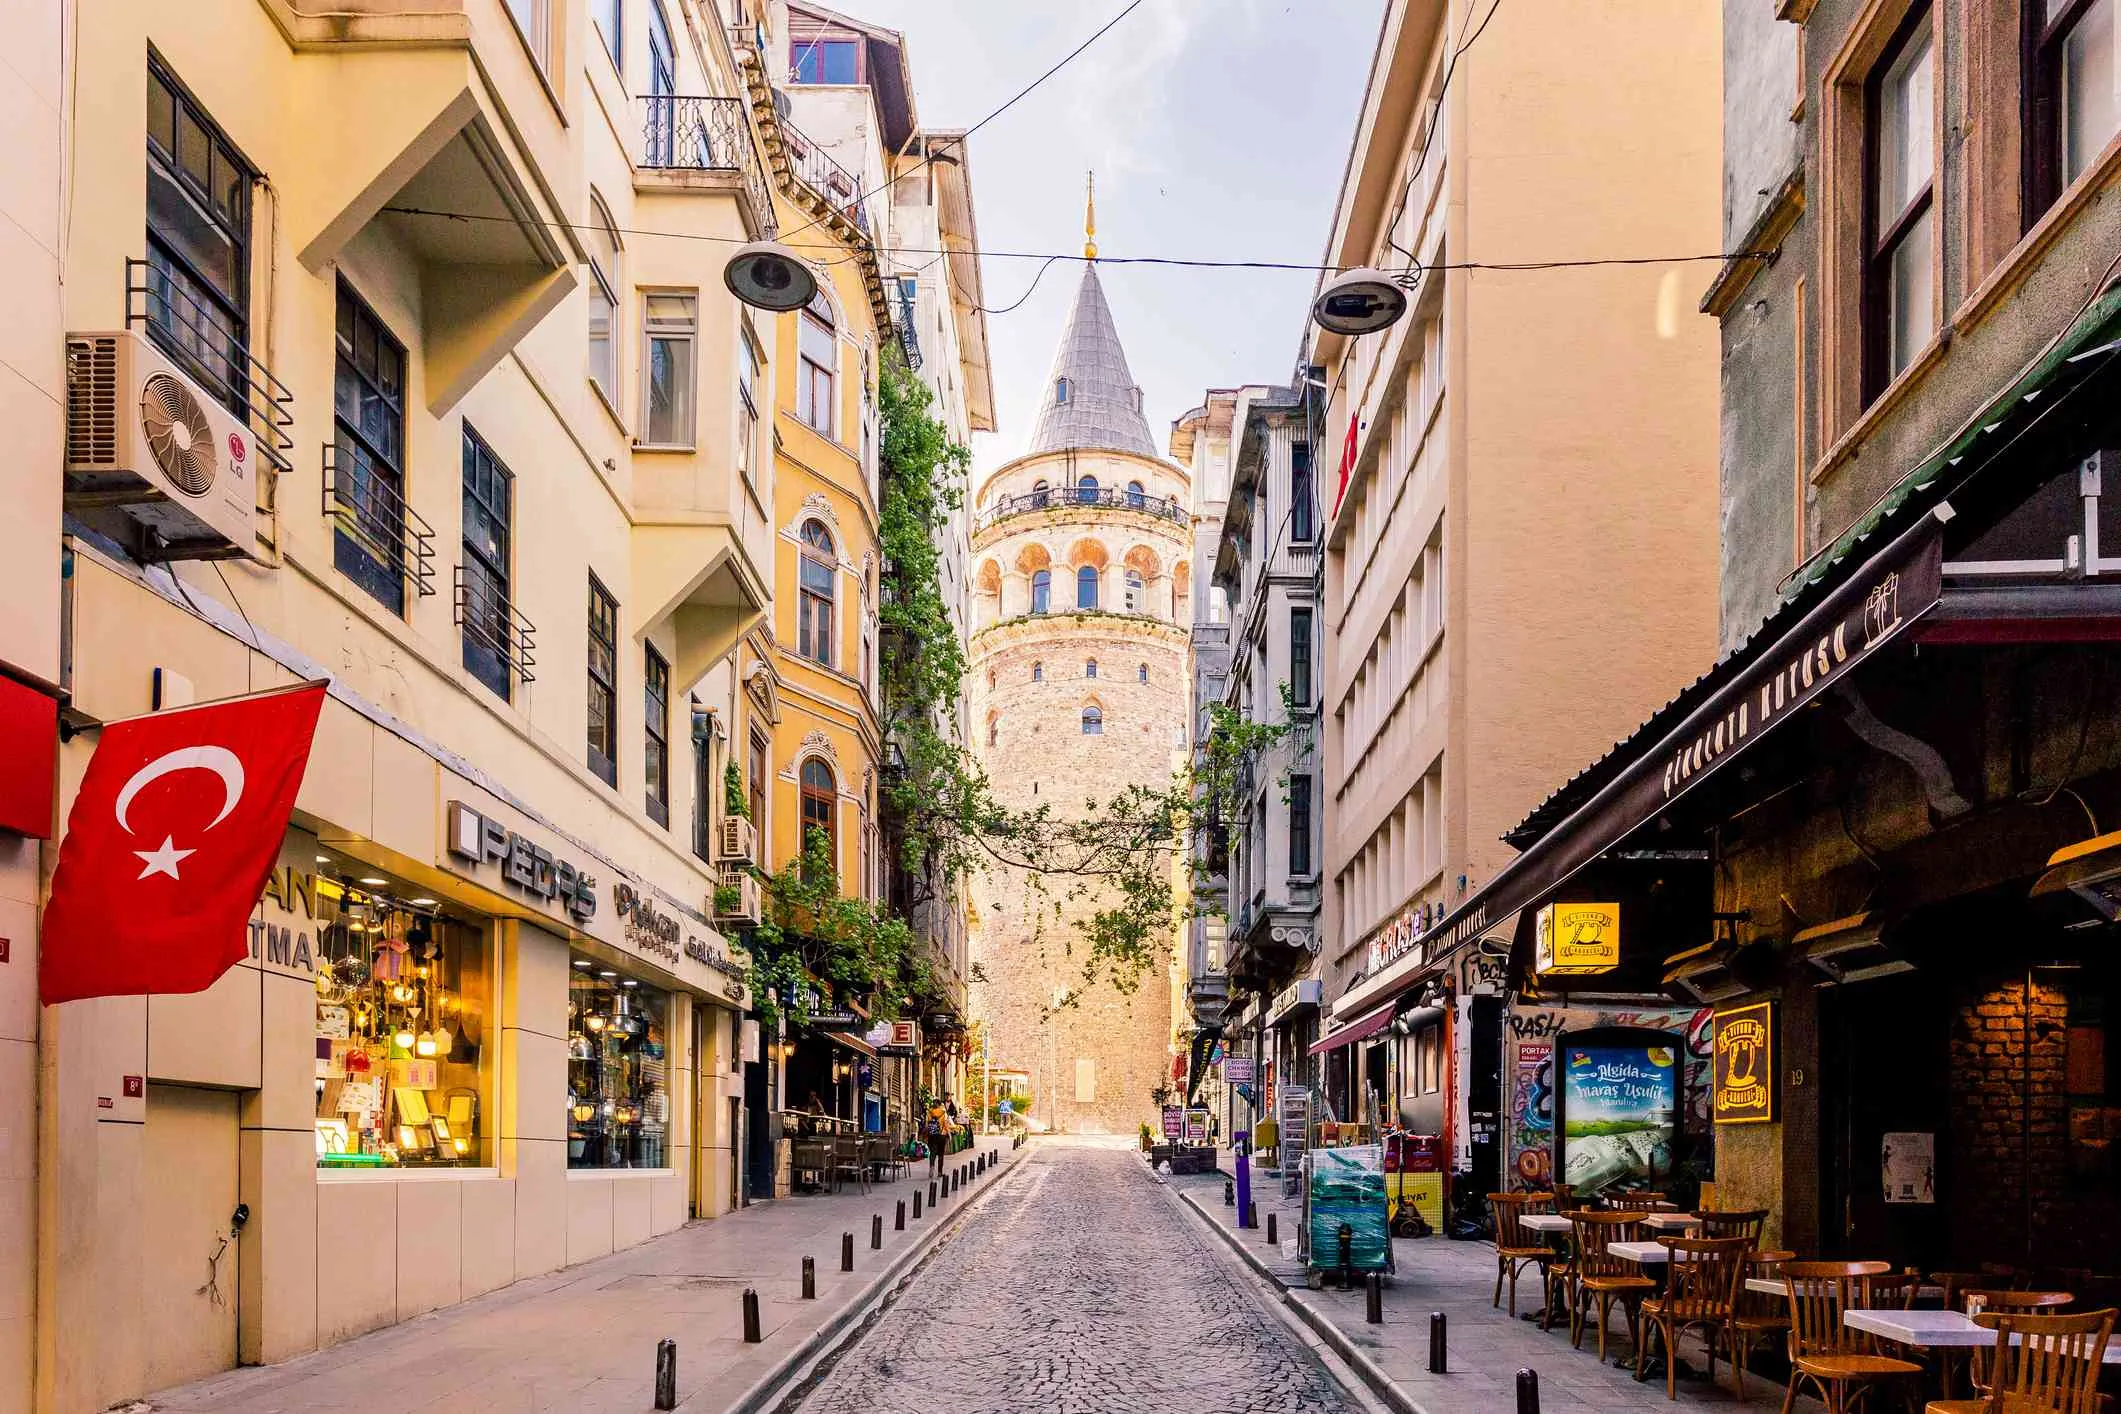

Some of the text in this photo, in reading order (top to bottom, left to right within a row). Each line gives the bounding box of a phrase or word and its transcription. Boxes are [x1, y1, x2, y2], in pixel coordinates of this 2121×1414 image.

[231, 460, 243, 480] LG
[1663, 621, 1847, 799] ÇİKOLATA KUTUSU
[264, 865, 318, 919] AN
[247, 918, 314, 972] TMA
[1521, 1047, 1550, 1055] PORTAK
[1598, 1063, 1639, 1081] Algida
[1792, 1069, 1803, 1086] 19
